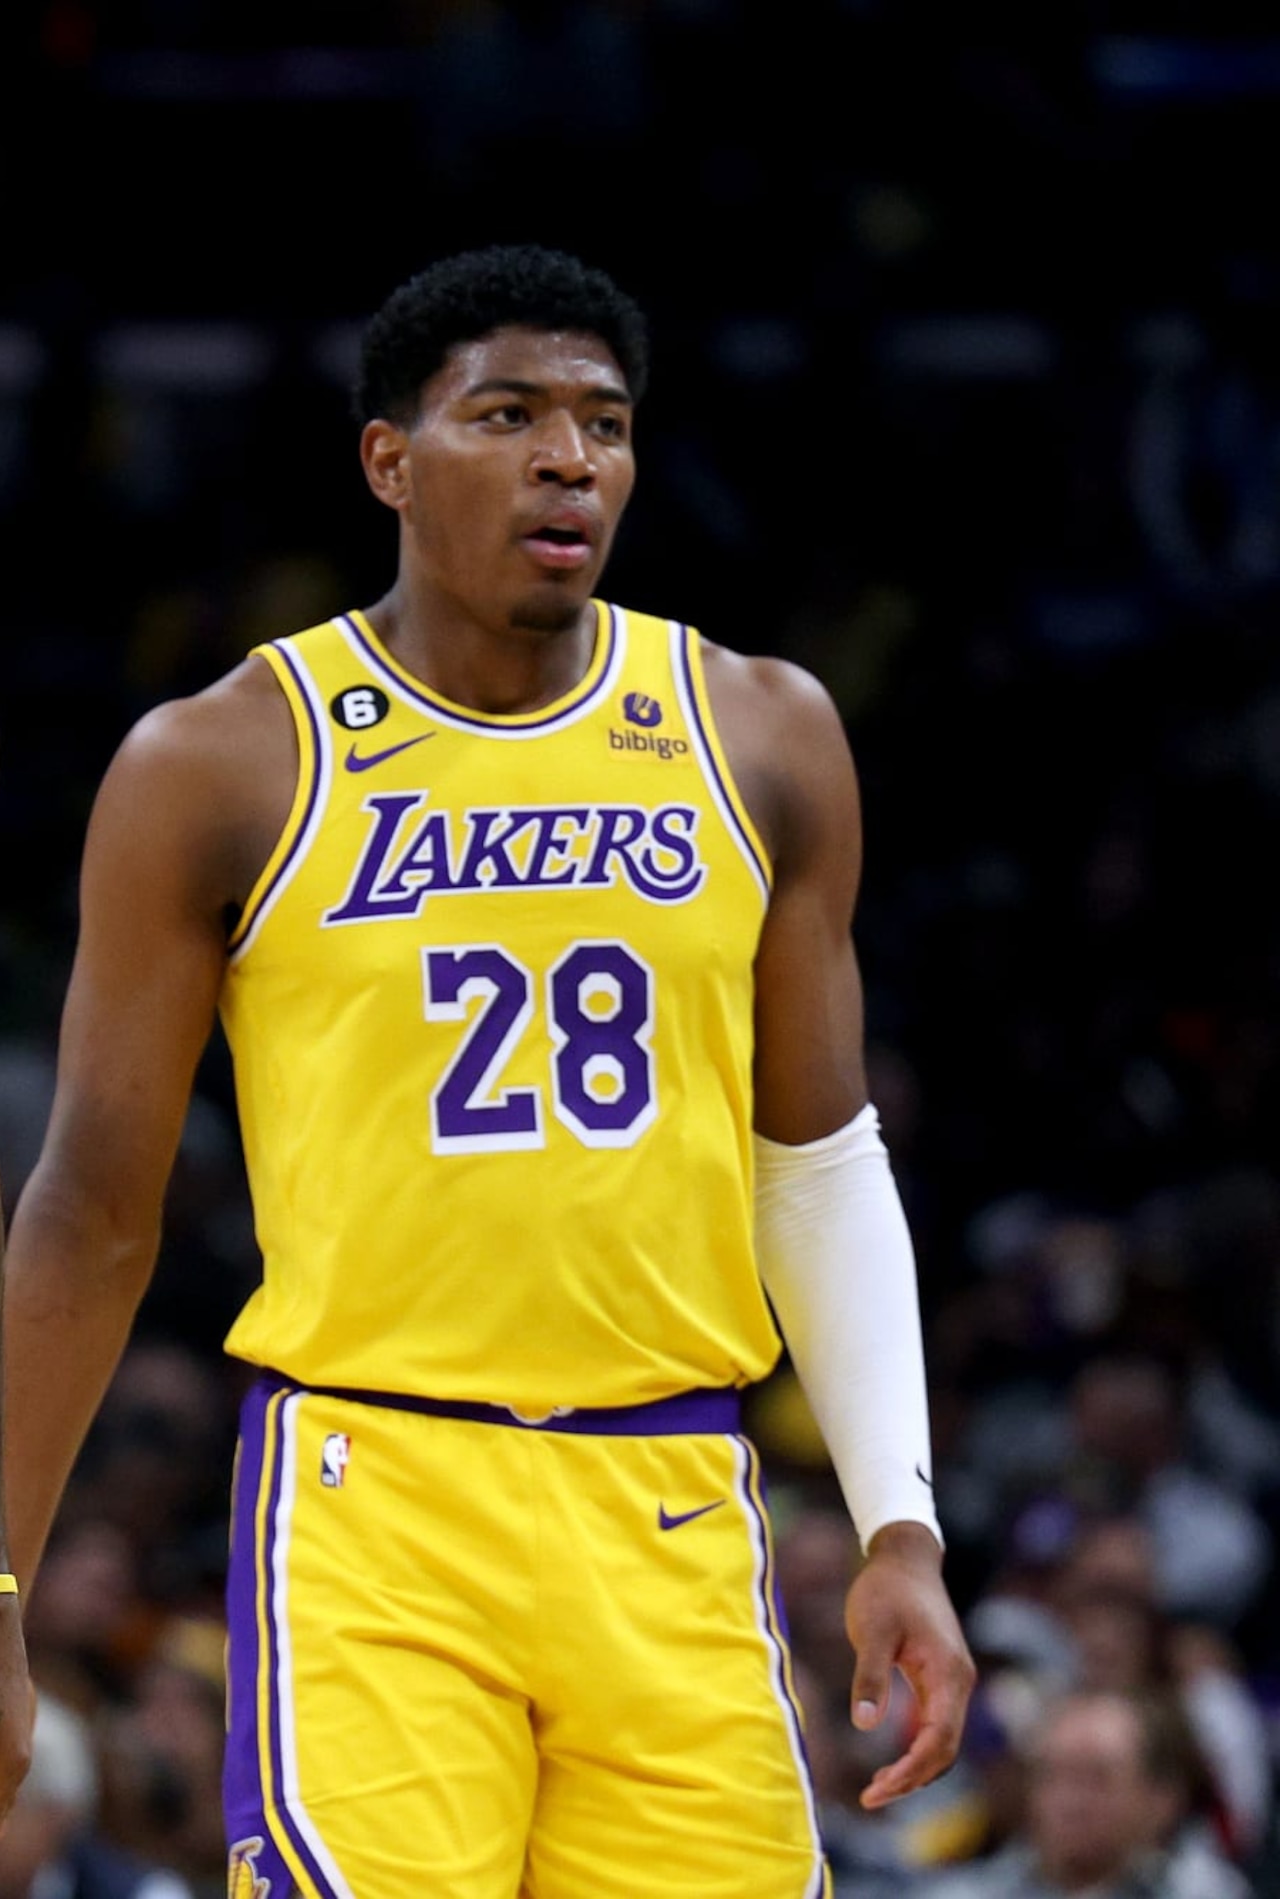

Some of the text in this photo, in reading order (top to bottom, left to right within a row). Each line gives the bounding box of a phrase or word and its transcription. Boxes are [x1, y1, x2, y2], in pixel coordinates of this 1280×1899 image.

[342, 690, 378, 727] 6
[609, 729, 689, 760] bibigo
[320, 789, 709, 927] LAKERS
[421, 939, 658, 1156] 28
